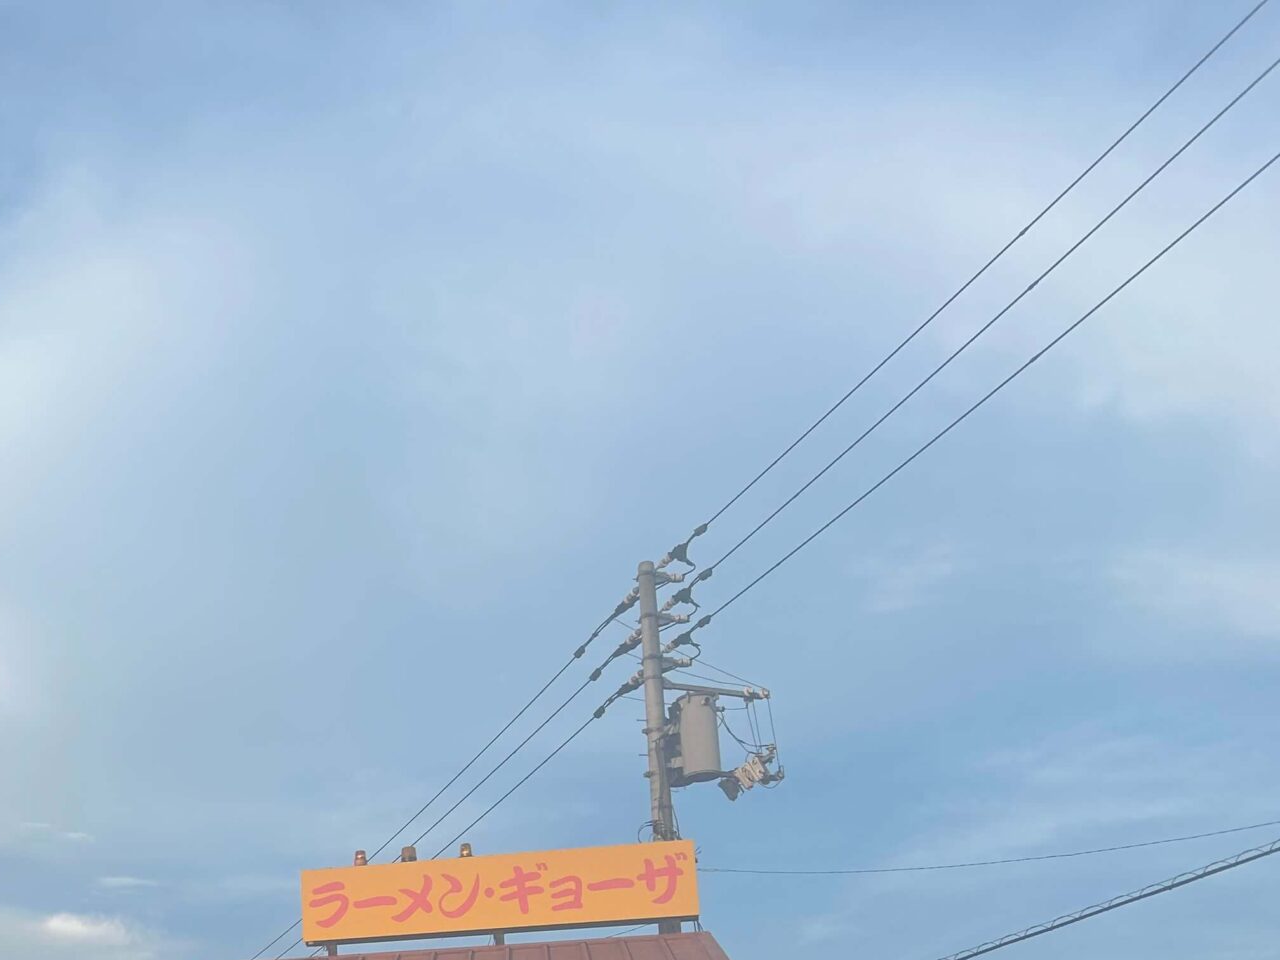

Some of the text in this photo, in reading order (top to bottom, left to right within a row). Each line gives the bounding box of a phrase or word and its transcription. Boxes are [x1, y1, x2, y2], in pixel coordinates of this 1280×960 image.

[308, 852, 689, 929] ラーメン・ギョーザ
